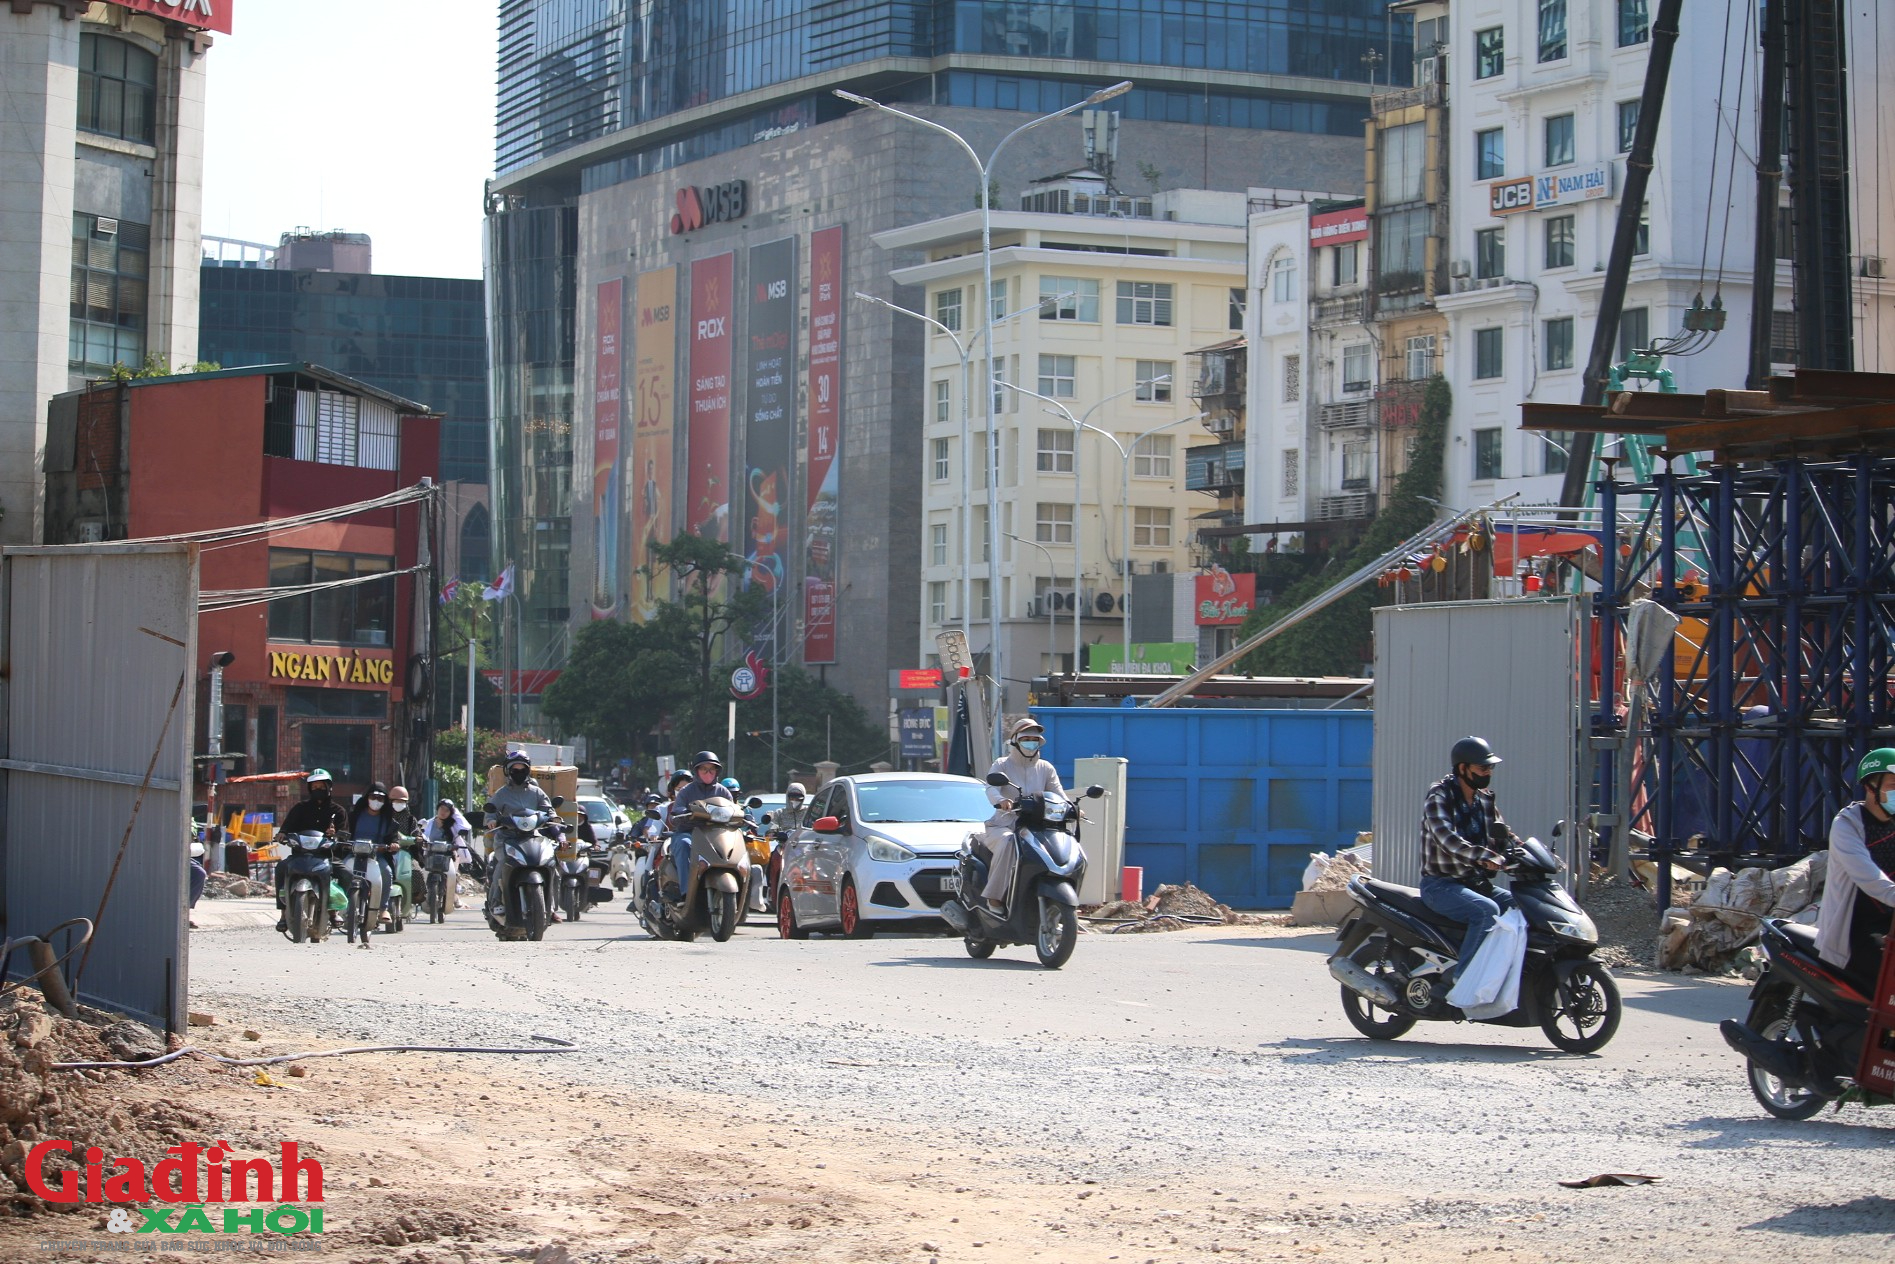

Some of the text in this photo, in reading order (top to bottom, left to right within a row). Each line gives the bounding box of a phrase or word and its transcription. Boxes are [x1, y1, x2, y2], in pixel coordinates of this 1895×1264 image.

[1558, 168, 1604, 193] NAM HẢI
[703, 179, 747, 225] MSB
[1492, 183, 1531, 210] JCB
[768, 280, 787, 300] MSB
[653, 305, 670, 322] MSB
[698, 316, 725, 341] ROX
[817, 374, 829, 403] 30
[638, 375, 661, 428] 15
[270, 648, 394, 684] NGAN VÀNG
[1862, 758, 1881, 770] Grab
[1871, 1065, 1885, 1078] BIA
